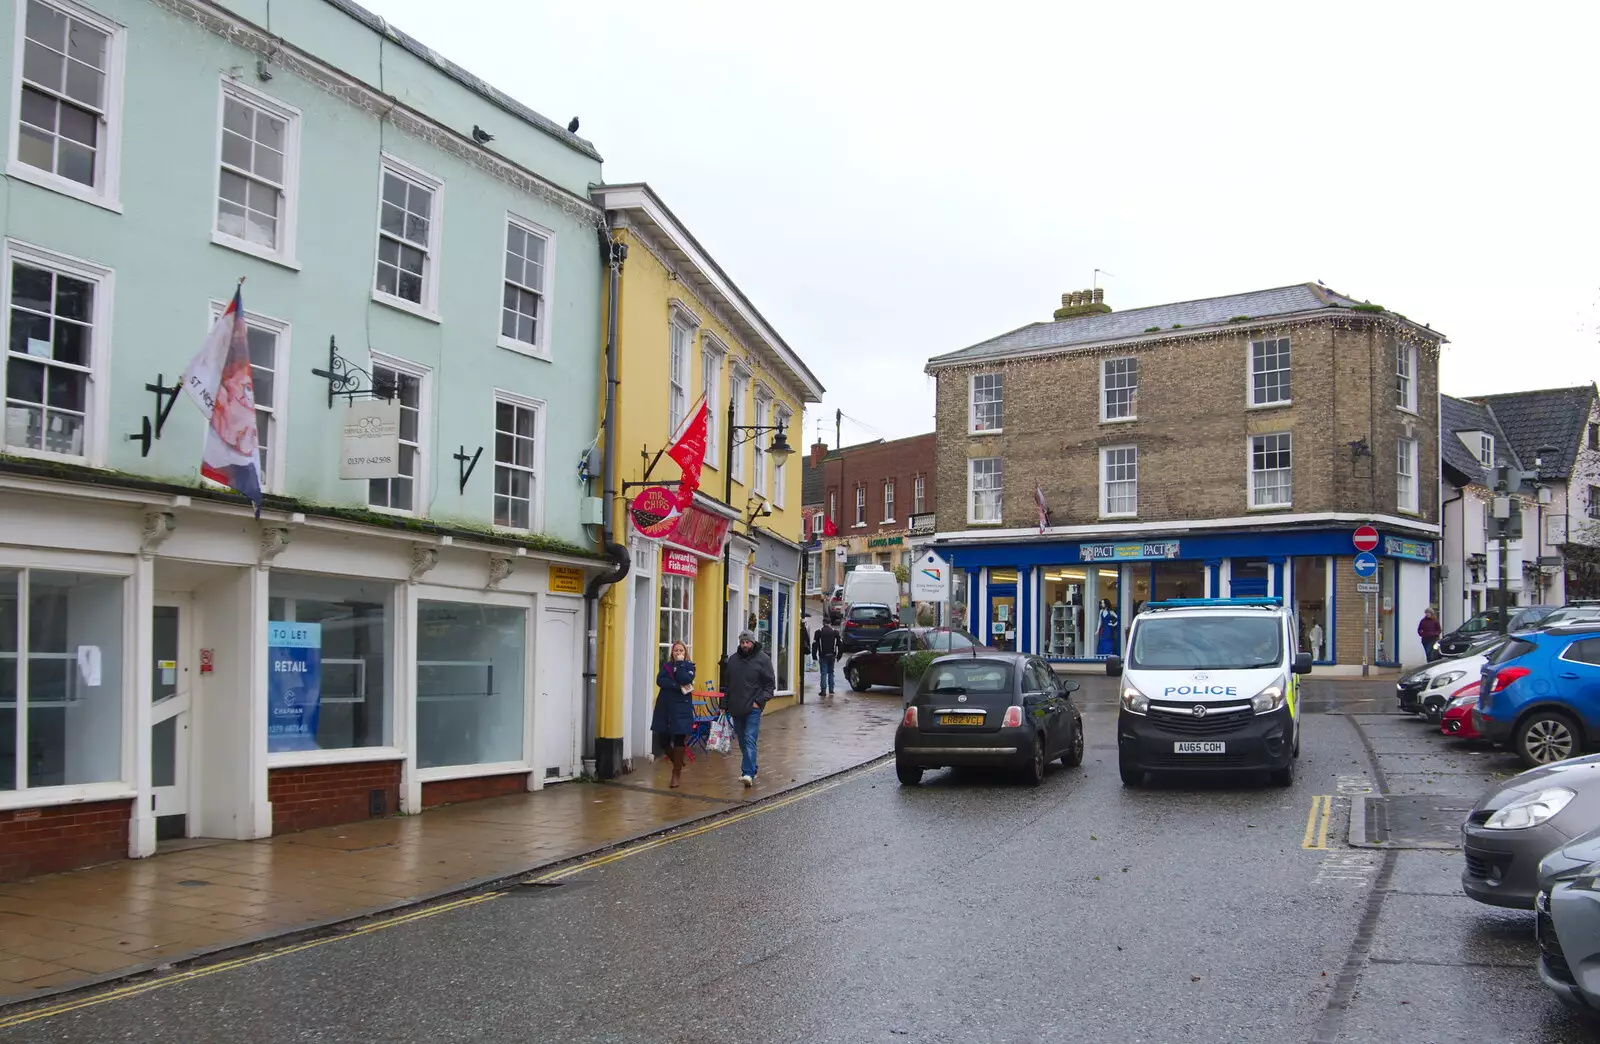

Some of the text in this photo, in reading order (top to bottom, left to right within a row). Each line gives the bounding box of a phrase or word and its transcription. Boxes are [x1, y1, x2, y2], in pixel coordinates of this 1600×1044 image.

[190, 375, 202, 388] ST
[347, 456, 391, 465] 01379 642598
[648, 491, 664, 501] MR
[644, 499, 669, 511] CHIPS
[1094, 546, 1113, 557] PACT
[1144, 544, 1165, 555] PACT
[669, 551, 689, 562] Award
[668, 560, 681, 570] Fish
[273, 629, 308, 640] TO LET
[274, 660, 308, 673] RETAIL
[1164, 685, 1237, 697] POLICE
[1178, 742, 1222, 752] AU65 COH
